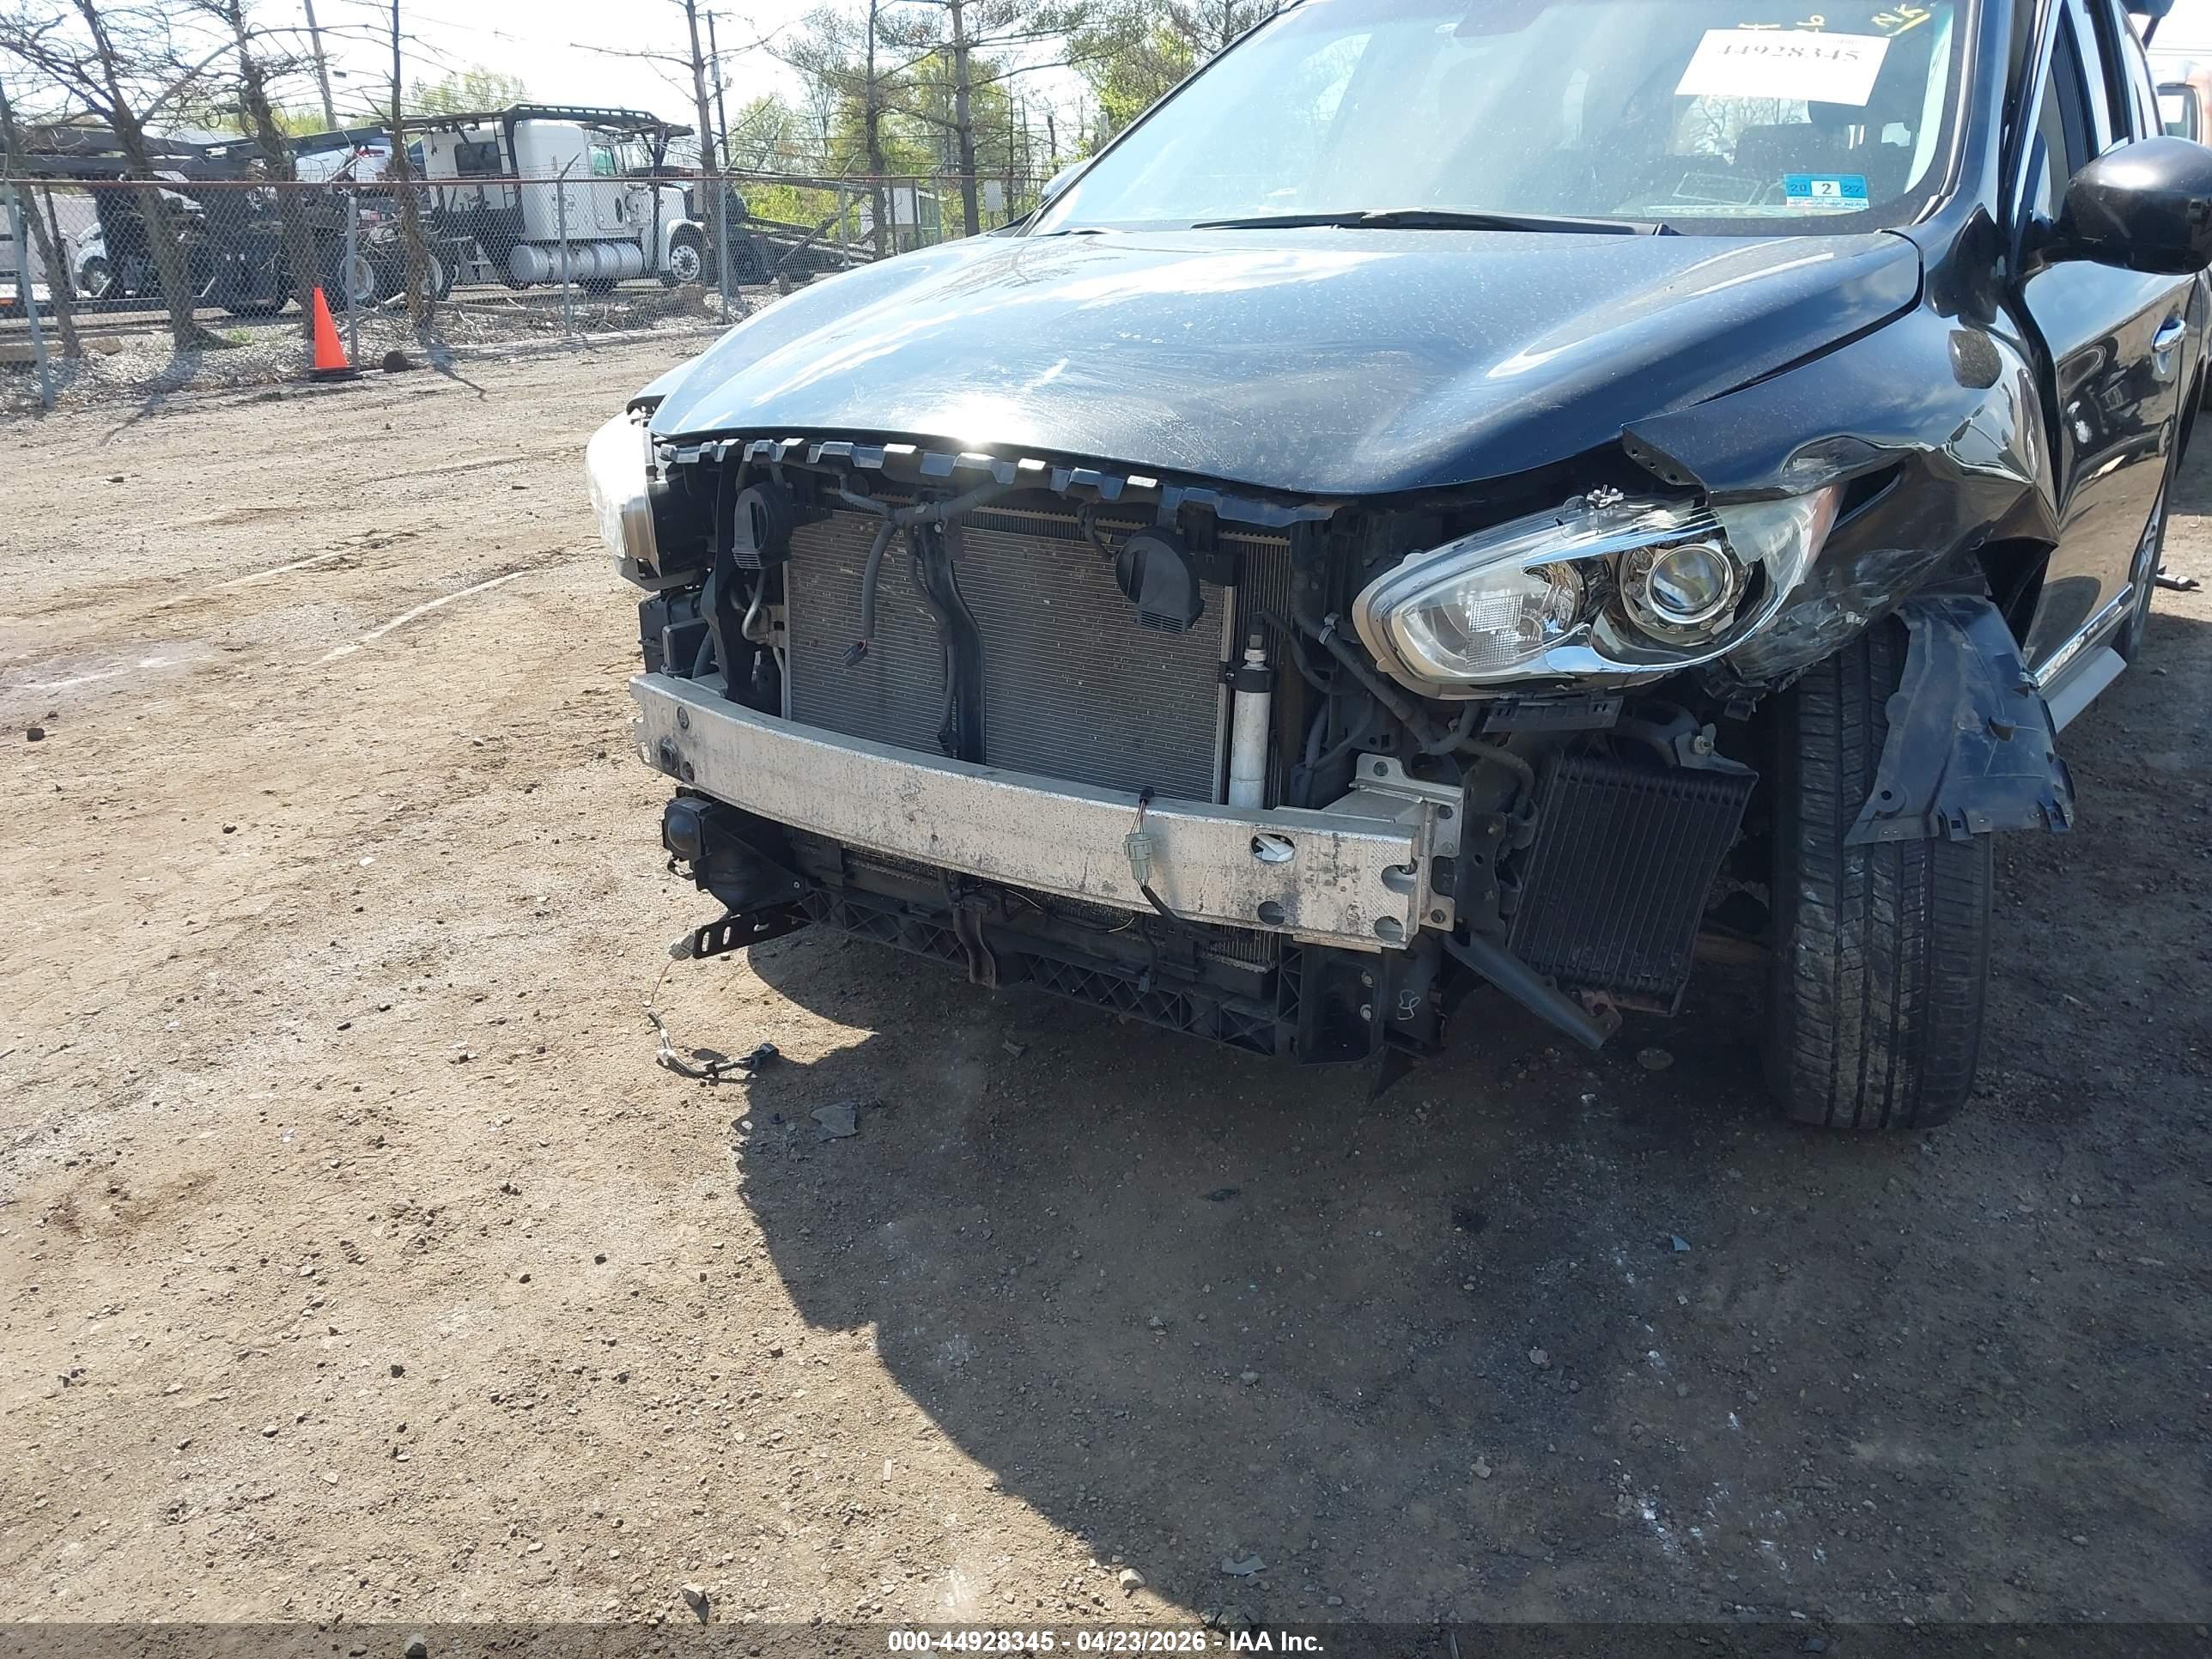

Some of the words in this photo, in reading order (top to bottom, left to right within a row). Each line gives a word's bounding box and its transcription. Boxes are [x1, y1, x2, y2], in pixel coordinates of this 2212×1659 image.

[1790, 184, 1807, 192] 20
[1820, 183, 1832, 194] 2
[1844, 185, 1862, 193] 27
